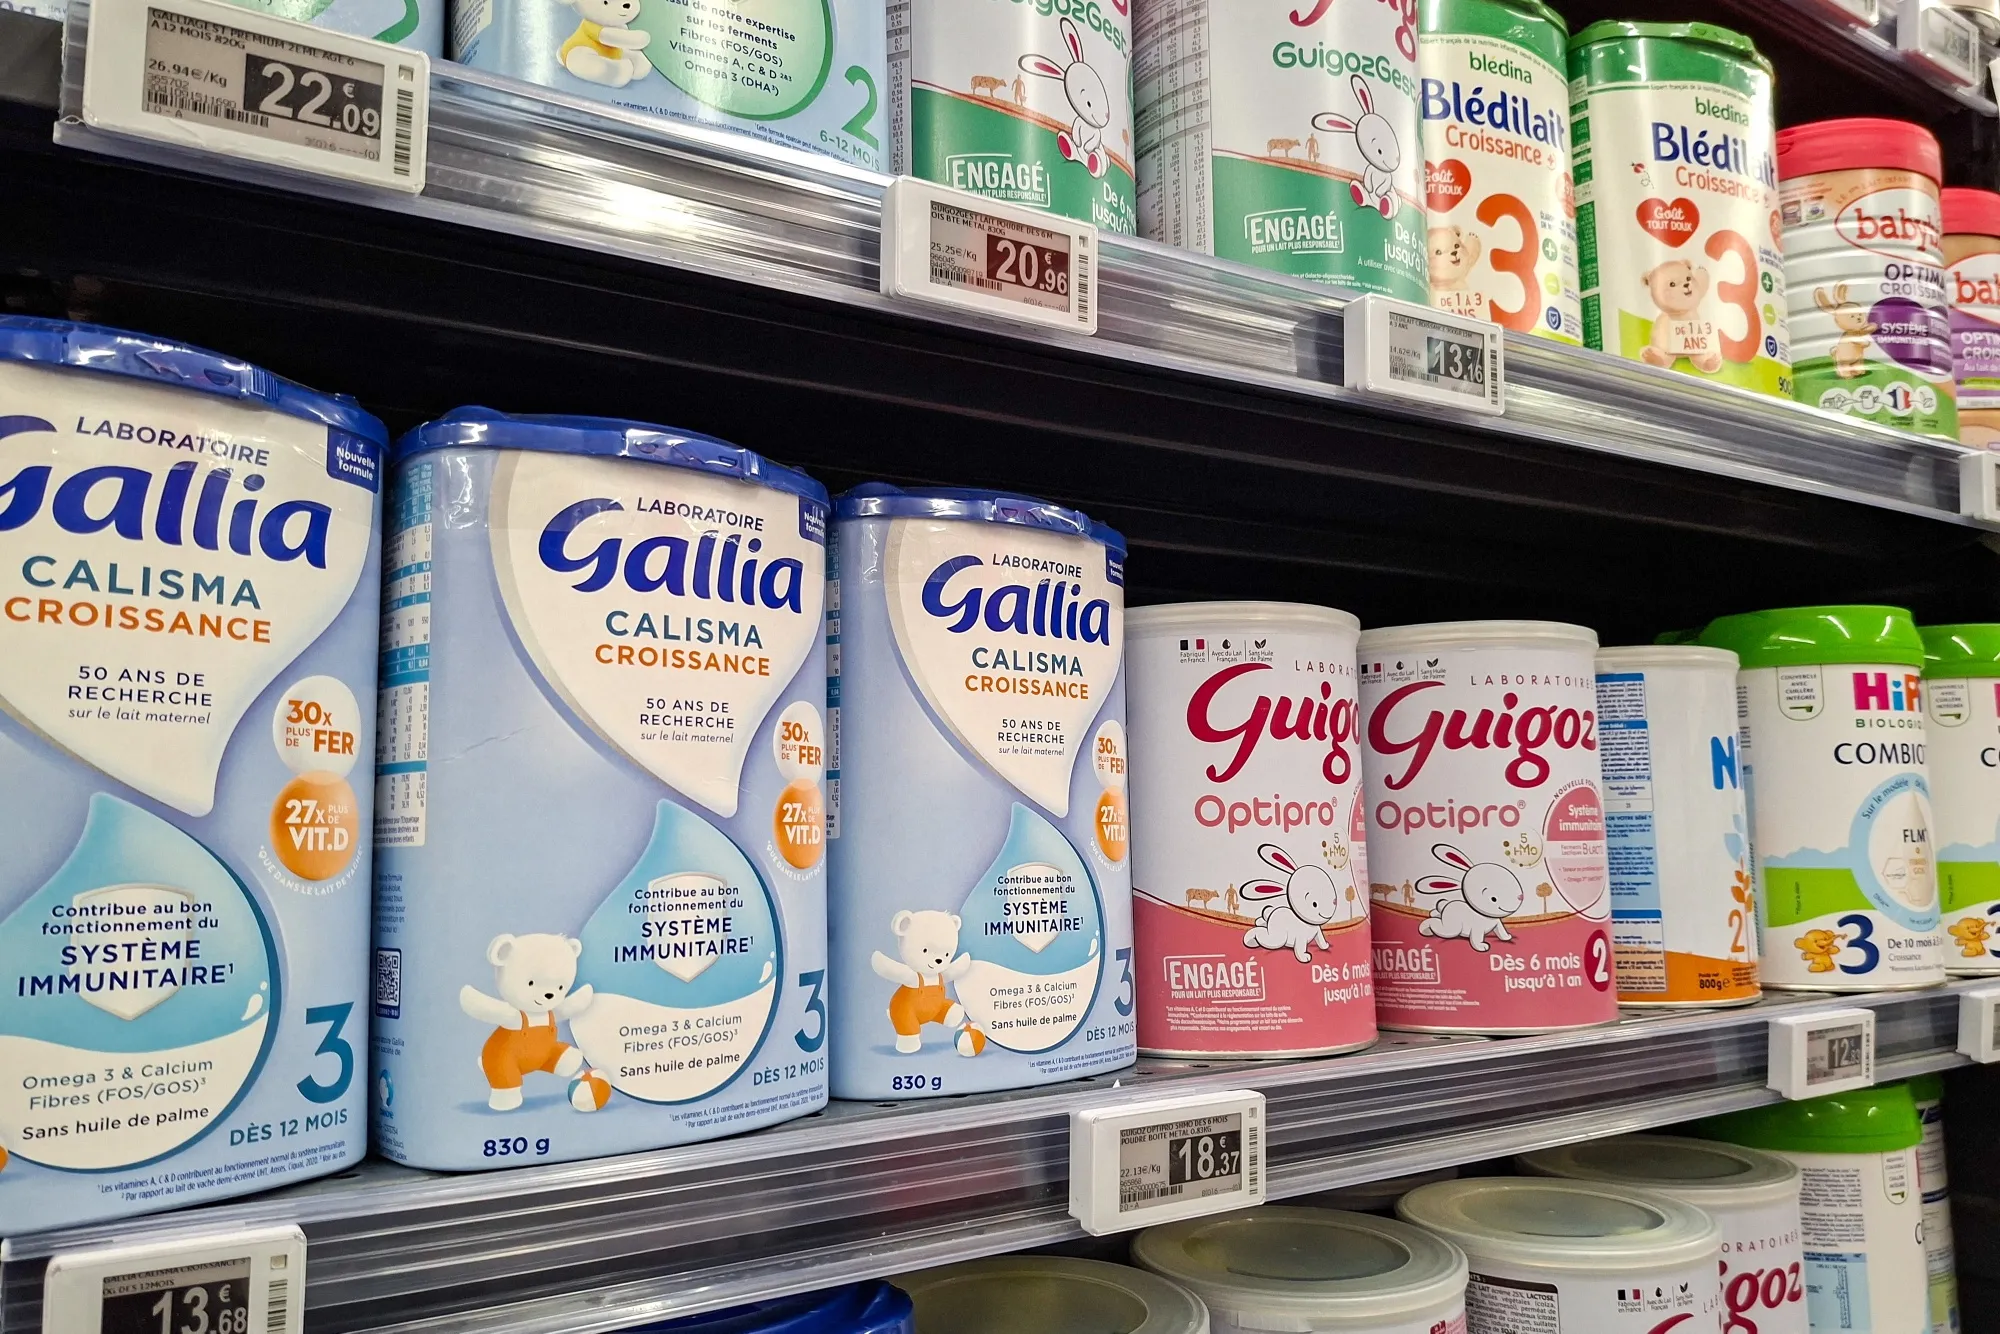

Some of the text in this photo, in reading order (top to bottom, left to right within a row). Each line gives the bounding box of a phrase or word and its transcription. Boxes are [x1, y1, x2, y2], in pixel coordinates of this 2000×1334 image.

[151, 19, 246, 51] A 12 MOIS 820G
[686, 15, 778, 50] sur les ferments
[693, 0, 796, 41] de notre expertise
[680, 27, 783, 68] Fibres (FOS/GOS)
[685, 60, 728, 80] Omega
[731, 73, 737, 82] 3
[1273, 41, 1416, 104] GuigozGest
[1469, 51, 1533, 85] blédina
[260, 62, 380, 137] 22.09
[843, 65, 880, 152] 2
[1421, 78, 1565, 153] Blédilait
[1695, 96, 1749, 127] blédina
[819, 129, 881, 172] 6-12 MOIS
[1446, 125, 1542, 166] Croissance
[952, 159, 1045, 193] ENGAGÉ
[1103, 181, 1118, 203] De
[931, 203, 978, 222] GUIGOZGEST
[980, 214, 995, 224] LAIT
[996, 218, 1024, 234] POUDRE
[1026, 226, 1040, 237] DES
[931, 211, 1006, 236] OIS BTE METAL 830G
[1251, 211, 1338, 245] ENGAGÉ
[1647, 220, 1693, 232] TOUT DOUX
[1654, 207, 1685, 220] Goût
[931, 242, 977, 262] 25.25€/Kg
[996, 240, 1068, 295] 20.96
[1476, 193, 1543, 330] 3
[1704, 229, 1762, 364] 3
[1683, 337, 1708, 352] ANS
[76, 416, 270, 466] LABORATOIRE
[336, 446, 377, 471] Nouvelle
[338, 460, 374, 482] formule
[636, 496, 764, 532] LABORATOIRE
[538, 497, 805, 614] Gallia
[22, 555, 262, 611] CALISMA
[921, 554, 1110, 646] Gallia
[4, 596, 272, 643] CROISSANCE
[605, 610, 763, 650] CALISMA
[594, 643, 770, 677] CROISSANCE
[972, 646, 1083, 678] CALISMA
[1260, 649, 1274, 657] Huile
[79, 665, 205, 687] 50 ANS DE
[964, 675, 1089, 700] CROISSANCE
[68, 685, 213, 707] RECHERCHE
[68, 706, 211, 725] sur le lait maternel
[998, 731, 1065, 744] RECHERCHE
[1368, 681, 1596, 791] Guigoz
[799, 745, 821, 765] FER
[1553, 778, 1584, 800] NOUVELLE
[1861, 778, 1909, 820] Sur le modèle
[1568, 804, 1598, 819] Système
[290, 827, 349, 852] VIT.D
[52, 900, 212, 919] Contribue au bon
[42, 916, 219, 936] fonctionnement du
[641, 916, 732, 938] SYSTÈME
[1728, 909, 1745, 953] 2
[1887, 935, 1932, 949] De 10 mois
[60, 937, 201, 966] SYSTÈME
[1593, 938, 1608, 983] 2
[1837, 914, 1880, 975] 3
[1888, 952, 1922, 963] Croissance
[1169, 956, 1259, 990] ENGAGÉ
[1311, 964, 1339, 984] Dès
[1342, 962, 1350, 980] 6
[1490, 952, 1580, 972] Dès 6 mois
[1558, 973, 1564, 987] 1
[1567, 976, 1582, 987] an
[794, 968, 826, 1054] 3
[296, 1000, 355, 1105] 3
[29, 1089, 90, 1110] Fibres
[22, 1106, 210, 1141] Sans huile de palme
[230, 1108, 348, 1147] DÈS 12 MOIS
[1120, 1128, 1147, 1138] GUIGOZ
[1146, 1122, 1174, 1134] OPTIPRO
[1194, 1118, 1207, 1128] DES
[1212, 1115, 1228, 1124] MOIS
[1121, 1126, 1212, 1145] POUDRE BOITE METAL 0.83KG
[1120, 1164, 1161, 1178] 22.13€/Kg
[1178, 1136, 1240, 1181] 18.37
[180, 1260, 236, 1274] CROISSANCE
